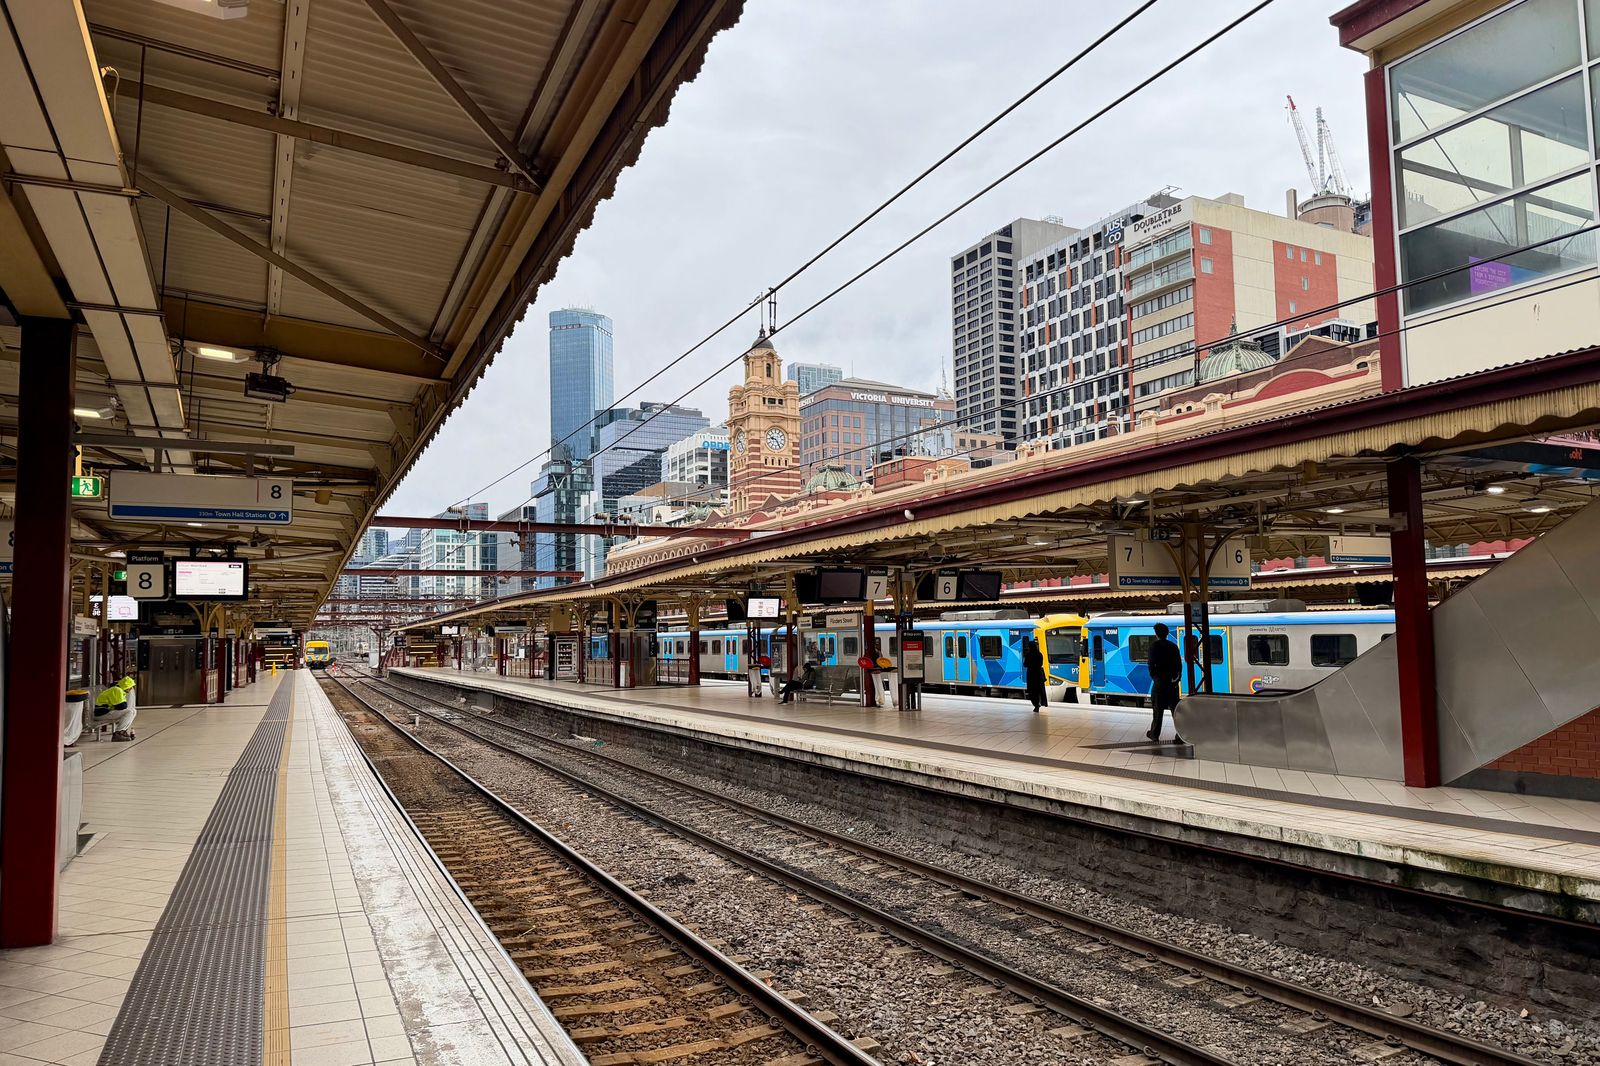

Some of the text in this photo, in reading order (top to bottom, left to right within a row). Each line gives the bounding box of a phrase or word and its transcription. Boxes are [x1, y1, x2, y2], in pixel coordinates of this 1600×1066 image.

[1134, 205, 1182, 232] DOUBLETREE
[850, 392, 935, 407] VICTORIA UNIVERSITY
[271, 485, 282, 499] 8
[1333, 540, 1338, 549] 7
[1124, 547, 1133, 562] 7
[1235, 549, 1243, 564] 6
[138, 572, 152, 590] 8
[873, 582, 881, 594] 7
[943, 581, 951, 594] 6
